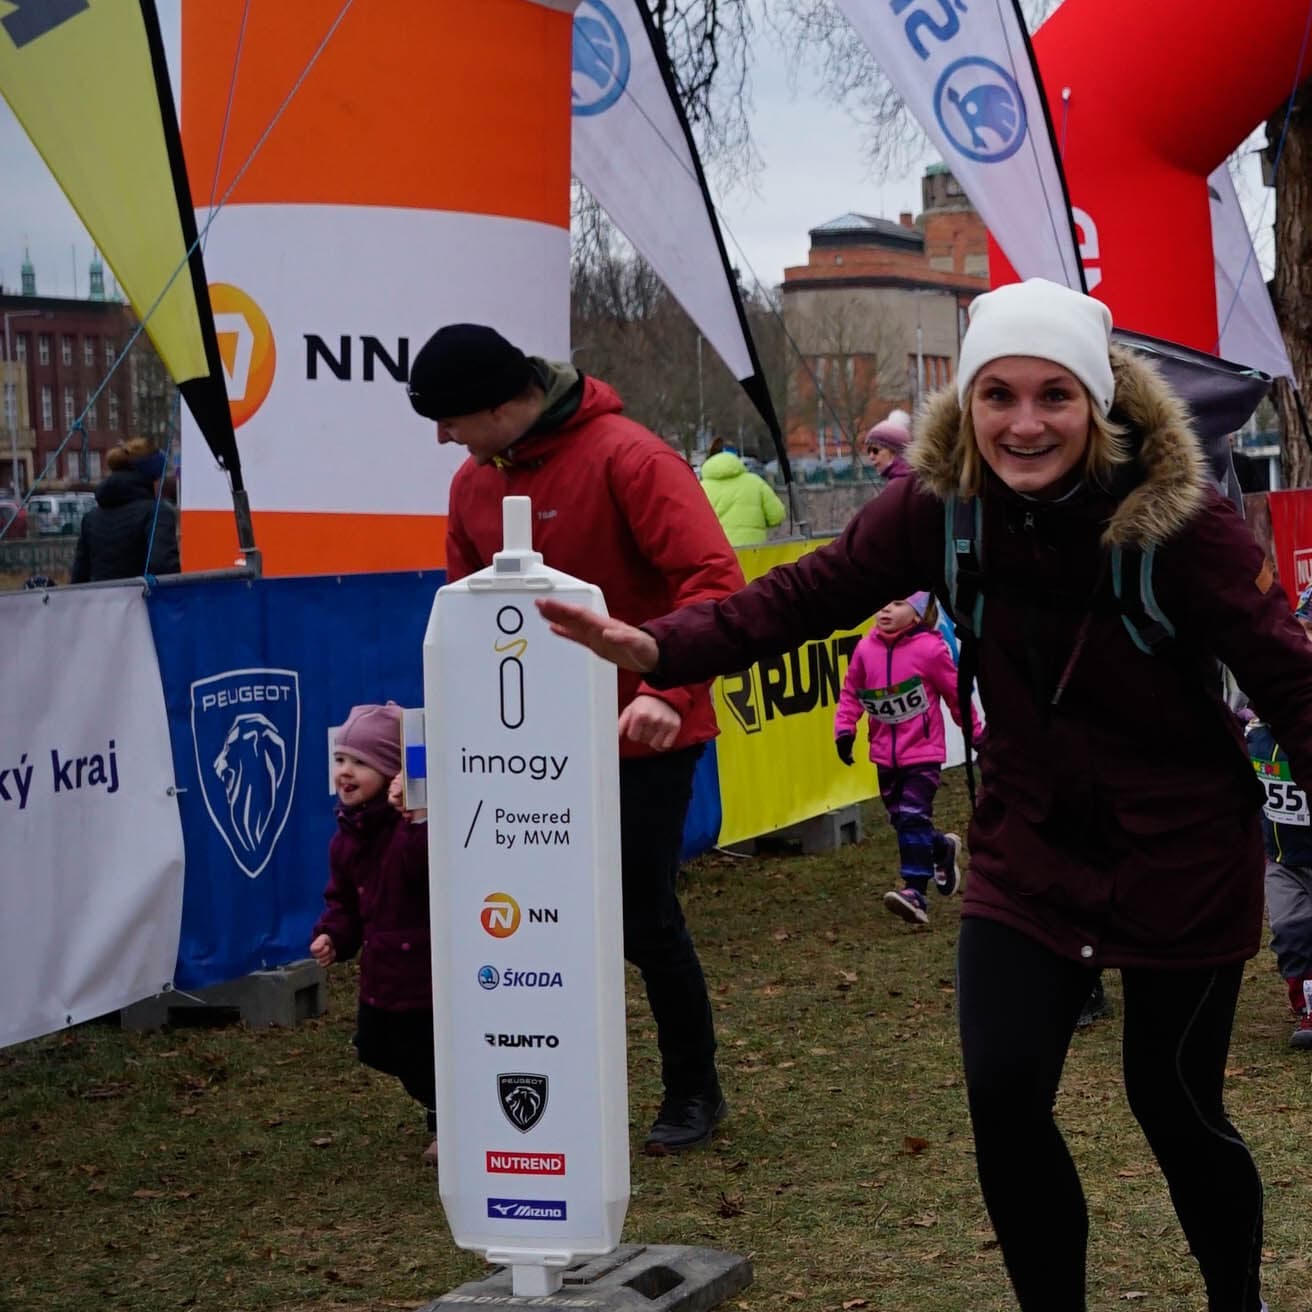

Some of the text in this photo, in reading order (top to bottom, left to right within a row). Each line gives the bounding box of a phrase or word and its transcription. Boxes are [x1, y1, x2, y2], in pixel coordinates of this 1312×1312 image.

[303, 334, 409, 383] NN
[757, 634, 863, 722] RUNT
[202, 685, 291, 713] PEUGEOT
[863, 689, 922, 716] 3416
[50, 739, 119, 794] kraj
[461, 747, 569, 781] innogy
[495, 807, 571, 824] Powered
[495, 829, 570, 849] by MVM
[528, 908, 559, 923] NN
[503, 968, 563, 988] ŠKODA
[498, 1034, 560, 1049] RUNTO
[501, 1077, 544, 1086] PEUGEOT
[490, 1155, 562, 1171] NUTREND
